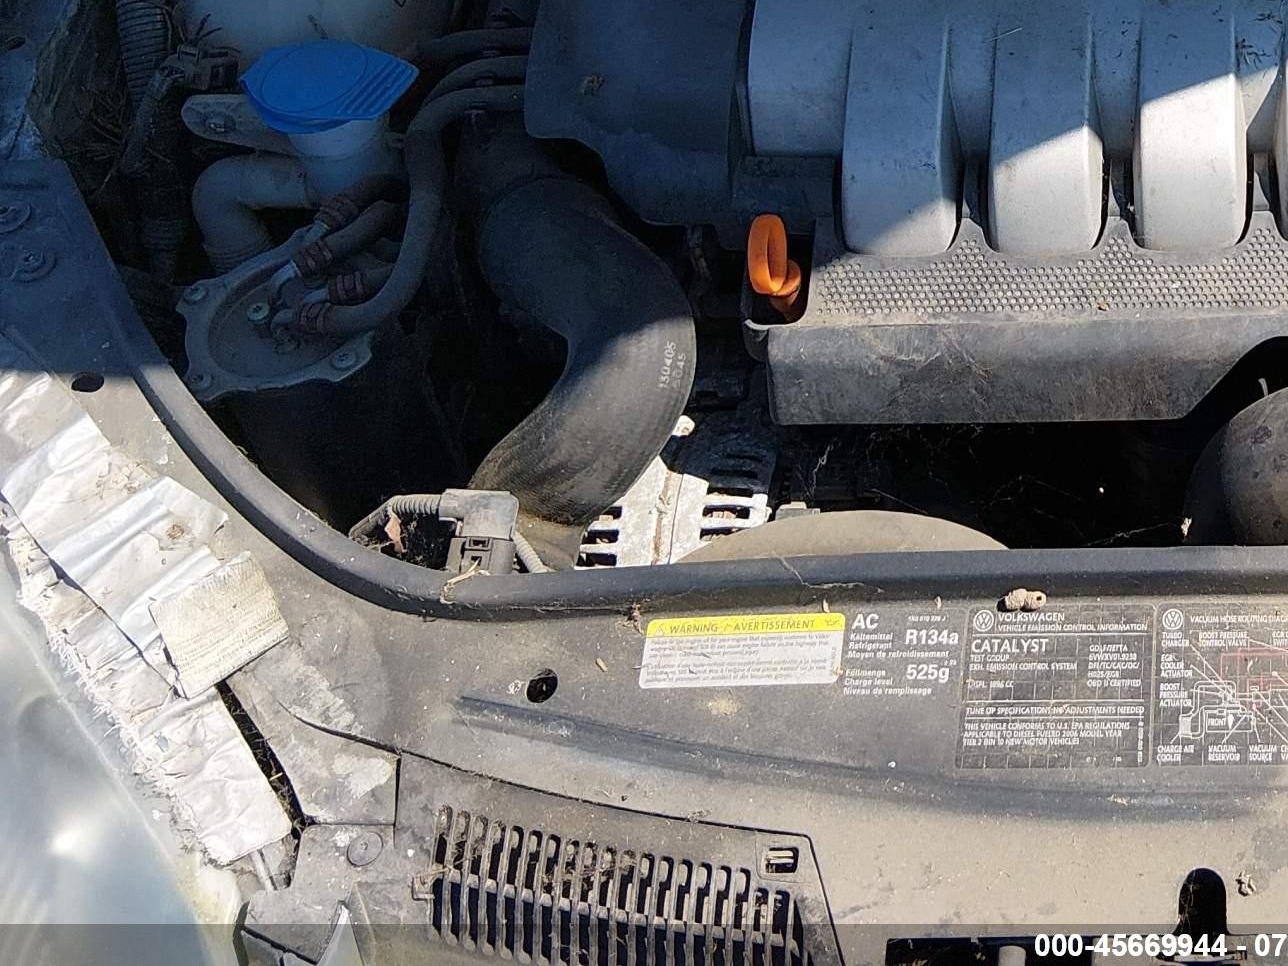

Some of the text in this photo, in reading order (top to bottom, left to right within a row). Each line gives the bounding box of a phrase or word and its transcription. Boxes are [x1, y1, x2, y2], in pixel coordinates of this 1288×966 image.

[851, 613, 880, 629] AC
[998, 613, 1065, 622] VOLKSWAGEN
[1190, 615, 1219, 624] VACUUM
[1220, 615, 1236, 624] HOSE
[1236, 615, 1268, 624] ROUTING
[670, 623, 719, 634] WARNING
[733, 619, 816, 631] AVERTISSEMENT
[998, 623, 1148, 632] VEHICLE EMISSION CONTROL INFORMATION
[904, 628, 960, 645] R134a
[971, 638, 1049, 653] CATALYST
[1161, 639, 1191, 647] CHARGER
[1227, 638, 1249, 646] VALVE
[847, 650, 875, 660] Moyen
[876, 650, 887, 658] de
[969, 654, 1010, 662] TEST GROUP
[986, 662, 1018, 670] EMISSION
[1019, 662, 1050, 670] CONTROL
[1050, 662, 1078, 670] SYSTEM
[1160, 661, 1185, 670] COOLER
[906, 663, 950, 684] 525g
[1160, 669, 1193, 677] ACTUATOR
[844, 677, 894, 687] Charge level
[1109, 679, 1142, 687] CERTIFIED
[1160, 682, 1180, 691] BOOST
[842, 687, 933, 697] Niveau de remplissage
[1159, 690, 1189, 699] PRESSURE
[1159, 698, 1192, 707] ACTUATOR
[966, 706, 985, 715] TUNE
[1065, 705, 1116, 715] ADJUSTMENTS
[1117, 705, 1145, 714] NEEDED
[965, 722, 979, 730] THIS
[980, 722, 1007, 730] VEHICLE
[1008, 722, 1045, 730] CONFORMS
[1046, 722, 1056, 730] TO
[1071, 721, 1084, 730] EPA
[1084, 721, 1131, 730] REGULATIONS
[1208, 718, 1227, 726] FRONT
[964, 730, 1001, 738] APPLICABLE
[1002, 730, 1013, 738] TO
[1013, 730, 1035, 738] DIESEL
[1036, 730, 1061, 738] FUELED
[1079, 730, 1104, 738] MODEL
[1105, 730, 1122, 738] YEAR
[963, 738, 977, 746] TIER
[983, 738, 996, 746] BIN
[1005, 738, 1022, 746] NEW
[1023, 737, 1048, 745] MOTOR
[1049, 737, 1080, 745] VEHICLES
[1157, 745, 1183, 753] CHARGE
[1208, 745, 1237, 753] VACUUM
[1249, 745, 1278, 753] VACUUM
[1156, 753, 1182, 762] COOLER
[1207, 753, 1241, 762] RESERVOIR
[1249, 753, 1274, 762] SOURCE
